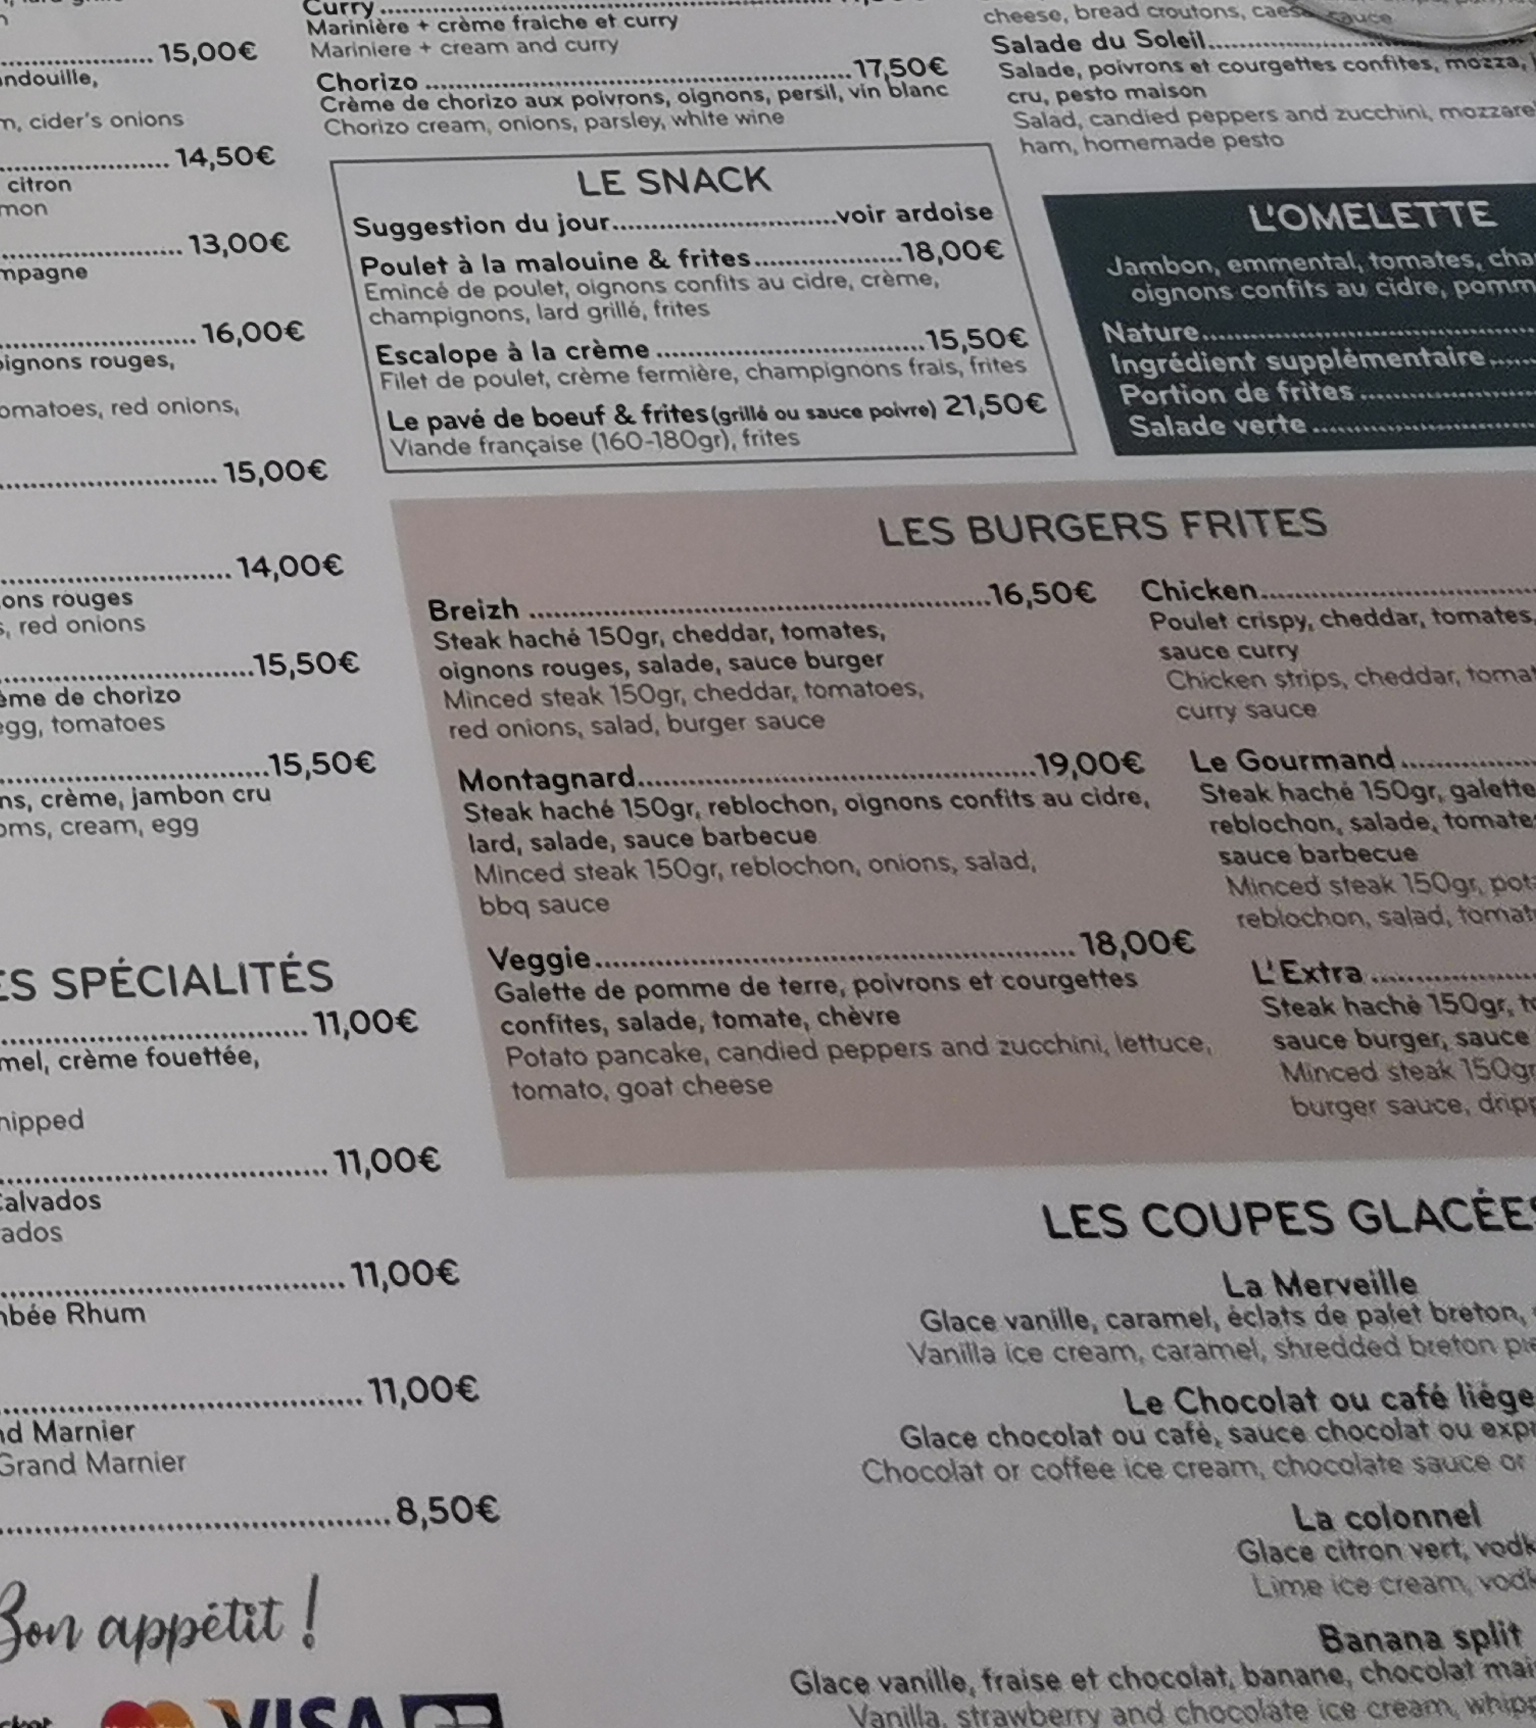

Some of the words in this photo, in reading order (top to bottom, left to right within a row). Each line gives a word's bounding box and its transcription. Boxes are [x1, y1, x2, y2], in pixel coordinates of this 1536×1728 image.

[578, 170, 626, 196] LE
[637, 166, 771, 195] SNACK
[353, 215, 505, 241] Suggestion
[516, 213, 548, 233] du
[558, 213, 609, 237] jour
[836, 204, 886, 224] voir
[896, 201, 993, 222] ardoise
[1248, 201, 1498, 232] L'OMELETTE
[376, 343, 497, 368] Escalope
[508, 342, 523, 362] à
[532, 340, 556, 361] la
[566, 339, 649, 360] crème
[926, 327, 1029, 354] 15,50€
[1102, 321, 1199, 343] Nature
[1129, 414, 1225, 437] Salade
[1233, 414, 1307, 435] verte
[223, 459, 328, 487] 15,00€
[879, 516, 955, 546] LES
[967, 511, 1168, 544] BURGERS
[1180, 507, 1327, 539] FRITES
[428, 597, 519, 622] Breizh
[988, 581, 1096, 609] 16,50€
[1141, 578, 1258, 602] Chicken
[268, 750, 376, 780] 15,50€
[487, 945, 590, 977] Veggie
[1079, 929, 1196, 961] 18,00€
[52, 951, 333, 1000] SPÉCIALITÉS
[1252, 960, 1363, 985] L'Extra
[313, 1008, 418, 1040] 11,00€
[1042, 1203, 1128, 1239] LES
[1142, 1200, 1335, 1238] COUPES
[1348, 1188, 1536, 1235] GLACÉE
[351, 1259, 459, 1293] 11,00€
[1222, 1271, 1263, 1298] La
[1272, 1268, 1418, 1297] Merveille
[368, 1375, 479, 1410] 11,00€
[397, 1495, 500, 1531] 8,50€
[97, 1596, 284, 1665] appétit
[1317, 1624, 1445, 1654] Banana
[1453, 1620, 1522, 1656] split
